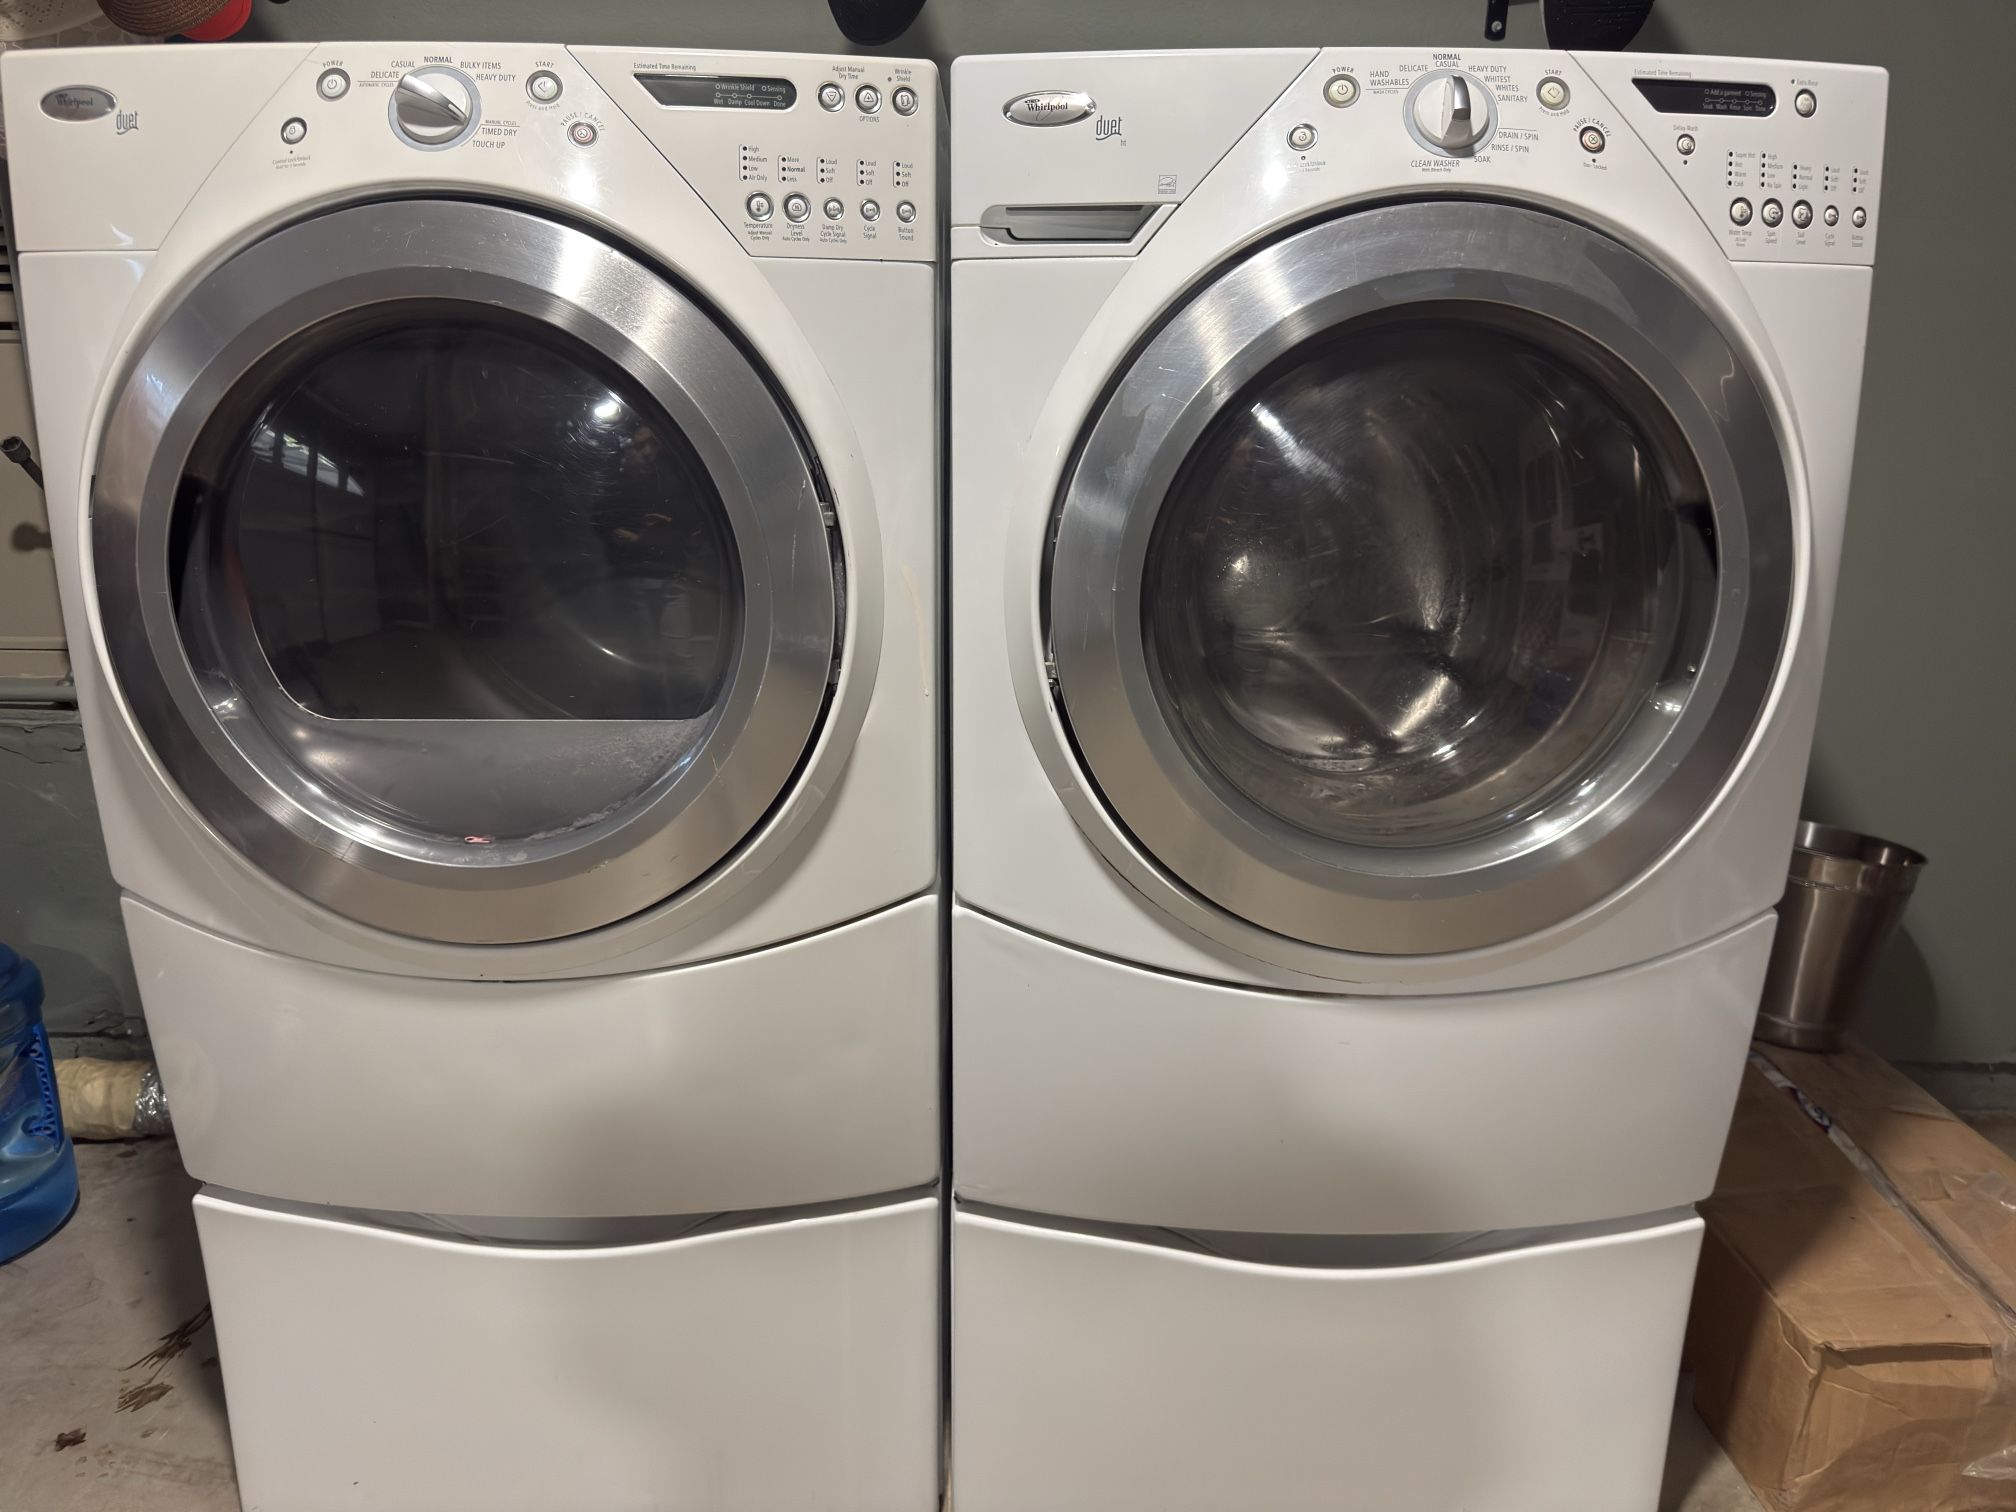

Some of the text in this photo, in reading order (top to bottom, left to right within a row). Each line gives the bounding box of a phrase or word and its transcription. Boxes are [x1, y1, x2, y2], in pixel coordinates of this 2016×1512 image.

[322, 60, 343, 68] POWER
[391, 60, 415, 68] CASUAL
[423, 56, 453, 64] NORMAL
[1435, 60, 1461, 68] CASUAL
[460, 61, 501, 70] BULKY ITEMS
[633, 62, 658, 70] Estimated
[671, 63, 697, 71] Remaining
[1332, 66, 1354, 74] POWER
[1399, 64, 1429, 72] DELICATE
[1490, 65, 1507, 73] DUTY
[370, 71, 399, 79] DELICATE
[475, 73, 516, 82] HEAVY DUTY
[1369, 70, 1390, 78] HAND
[1369, 78, 1410, 86] WASHABLES
[1484, 75, 1511, 83] WHITEST
[1495, 84, 1519, 92] WHITES
[1497, 94, 1528, 103] SANITARY
[1027, 102, 1068, 112] Whirlpool
[116, 108, 139, 135] duet
[560, 111, 578, 127] PAUSE
[1095, 115, 1123, 141] duet
[1573, 117, 1587, 132] PAUSE
[1592, 117, 1612, 137] CANCEL
[481, 127, 518, 137] TIMED DRY
[1498, 131, 1519, 139] DRAIN
[1524, 133, 1539, 141] SPIN
[472, 140, 506, 149] TOUCH UP
[1491, 143, 1510, 151] RINSE
[1514, 145, 1530, 153] SPIN
[1410, 159, 1460, 168] CLEAN WASHER
[1474, 155, 1491, 163] SOAK
